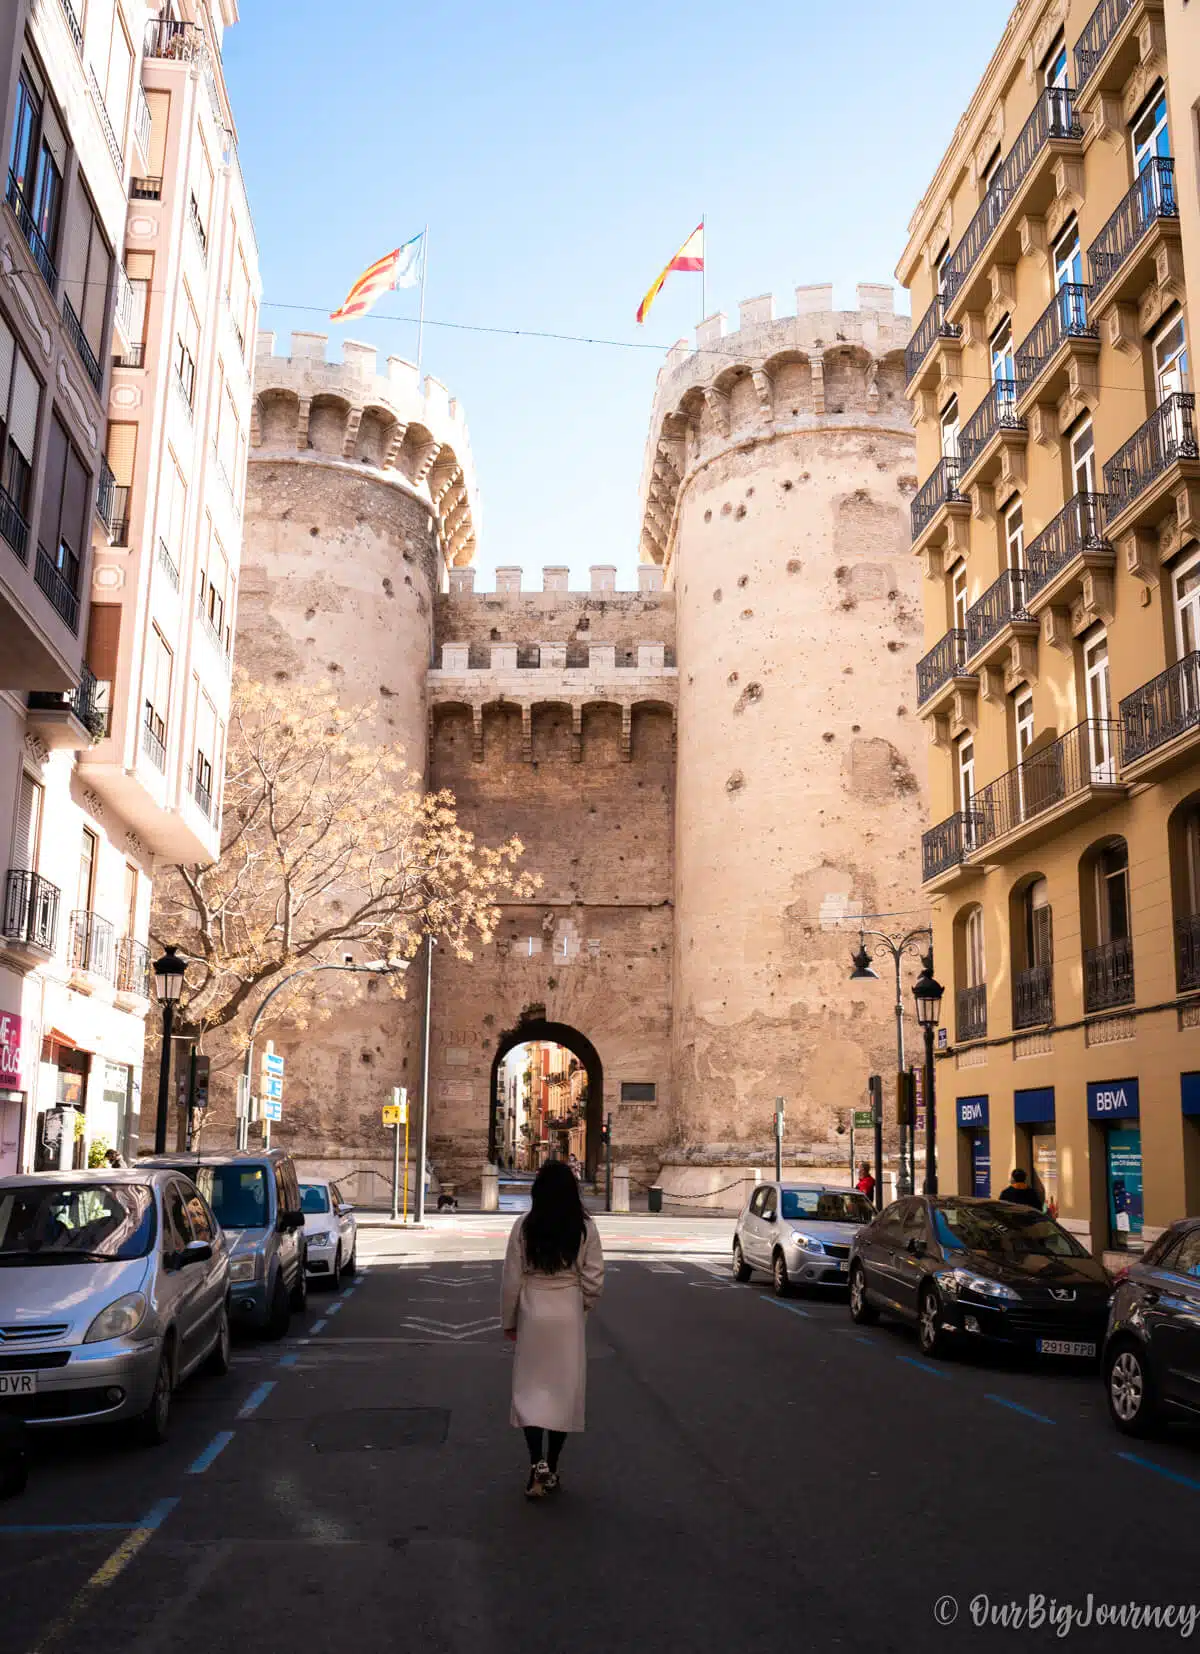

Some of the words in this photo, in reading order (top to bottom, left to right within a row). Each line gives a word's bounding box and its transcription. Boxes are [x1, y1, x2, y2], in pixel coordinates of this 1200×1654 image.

[1096, 1088, 1127, 1111] BBVA
[962, 1102, 982, 1120] BBVA
[1043, 1341, 1070, 1354] 2919
